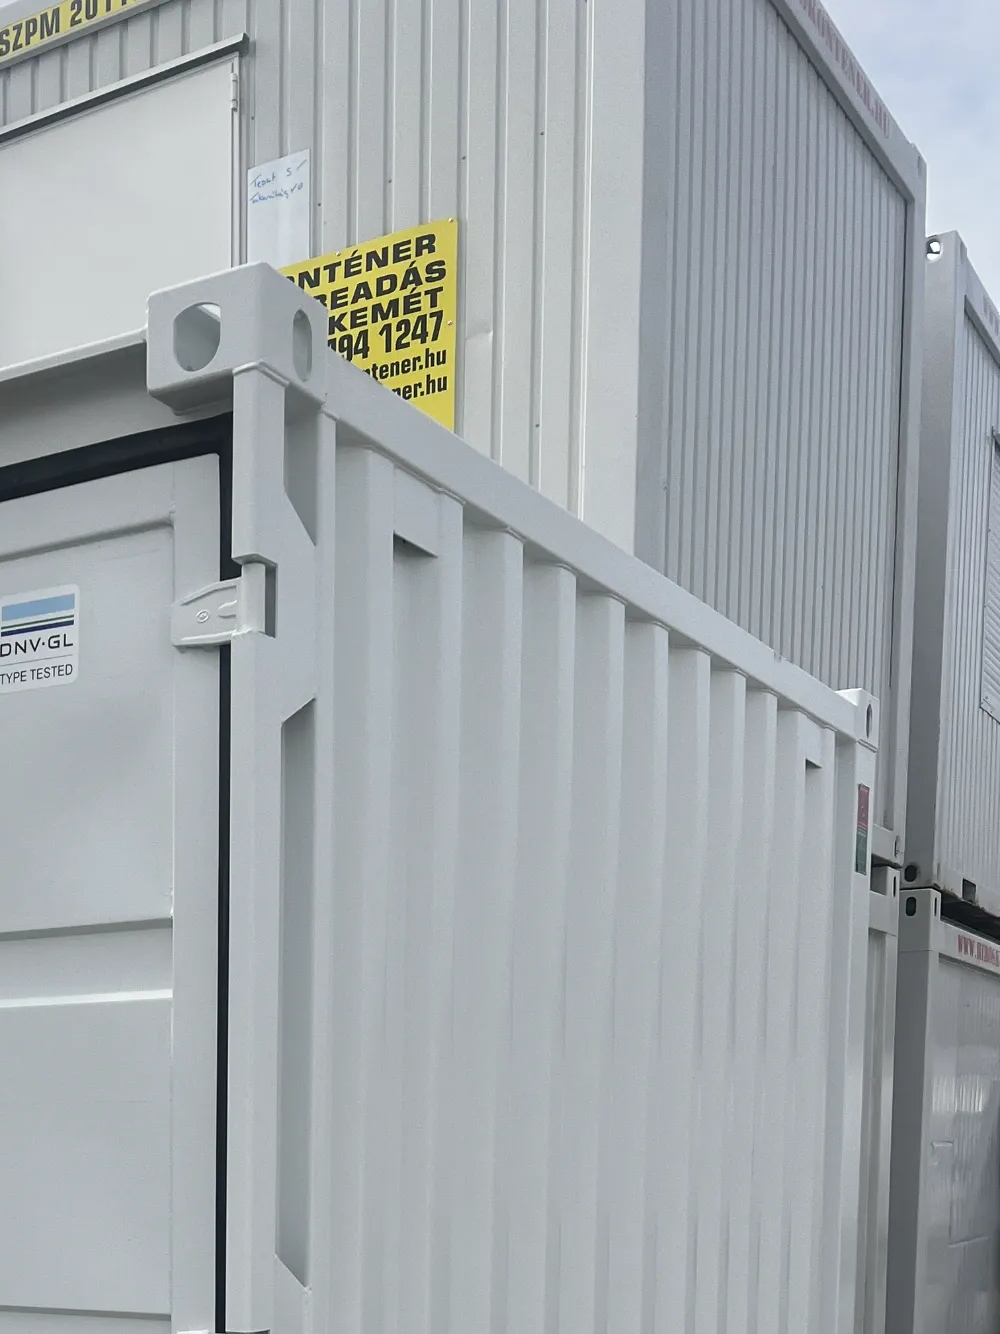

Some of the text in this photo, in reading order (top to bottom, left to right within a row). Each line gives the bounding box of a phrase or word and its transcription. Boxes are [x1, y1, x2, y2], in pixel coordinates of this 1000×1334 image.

[379, 310, 443, 353] 1247
[0, 663, 73, 685] TYPE TESTED
